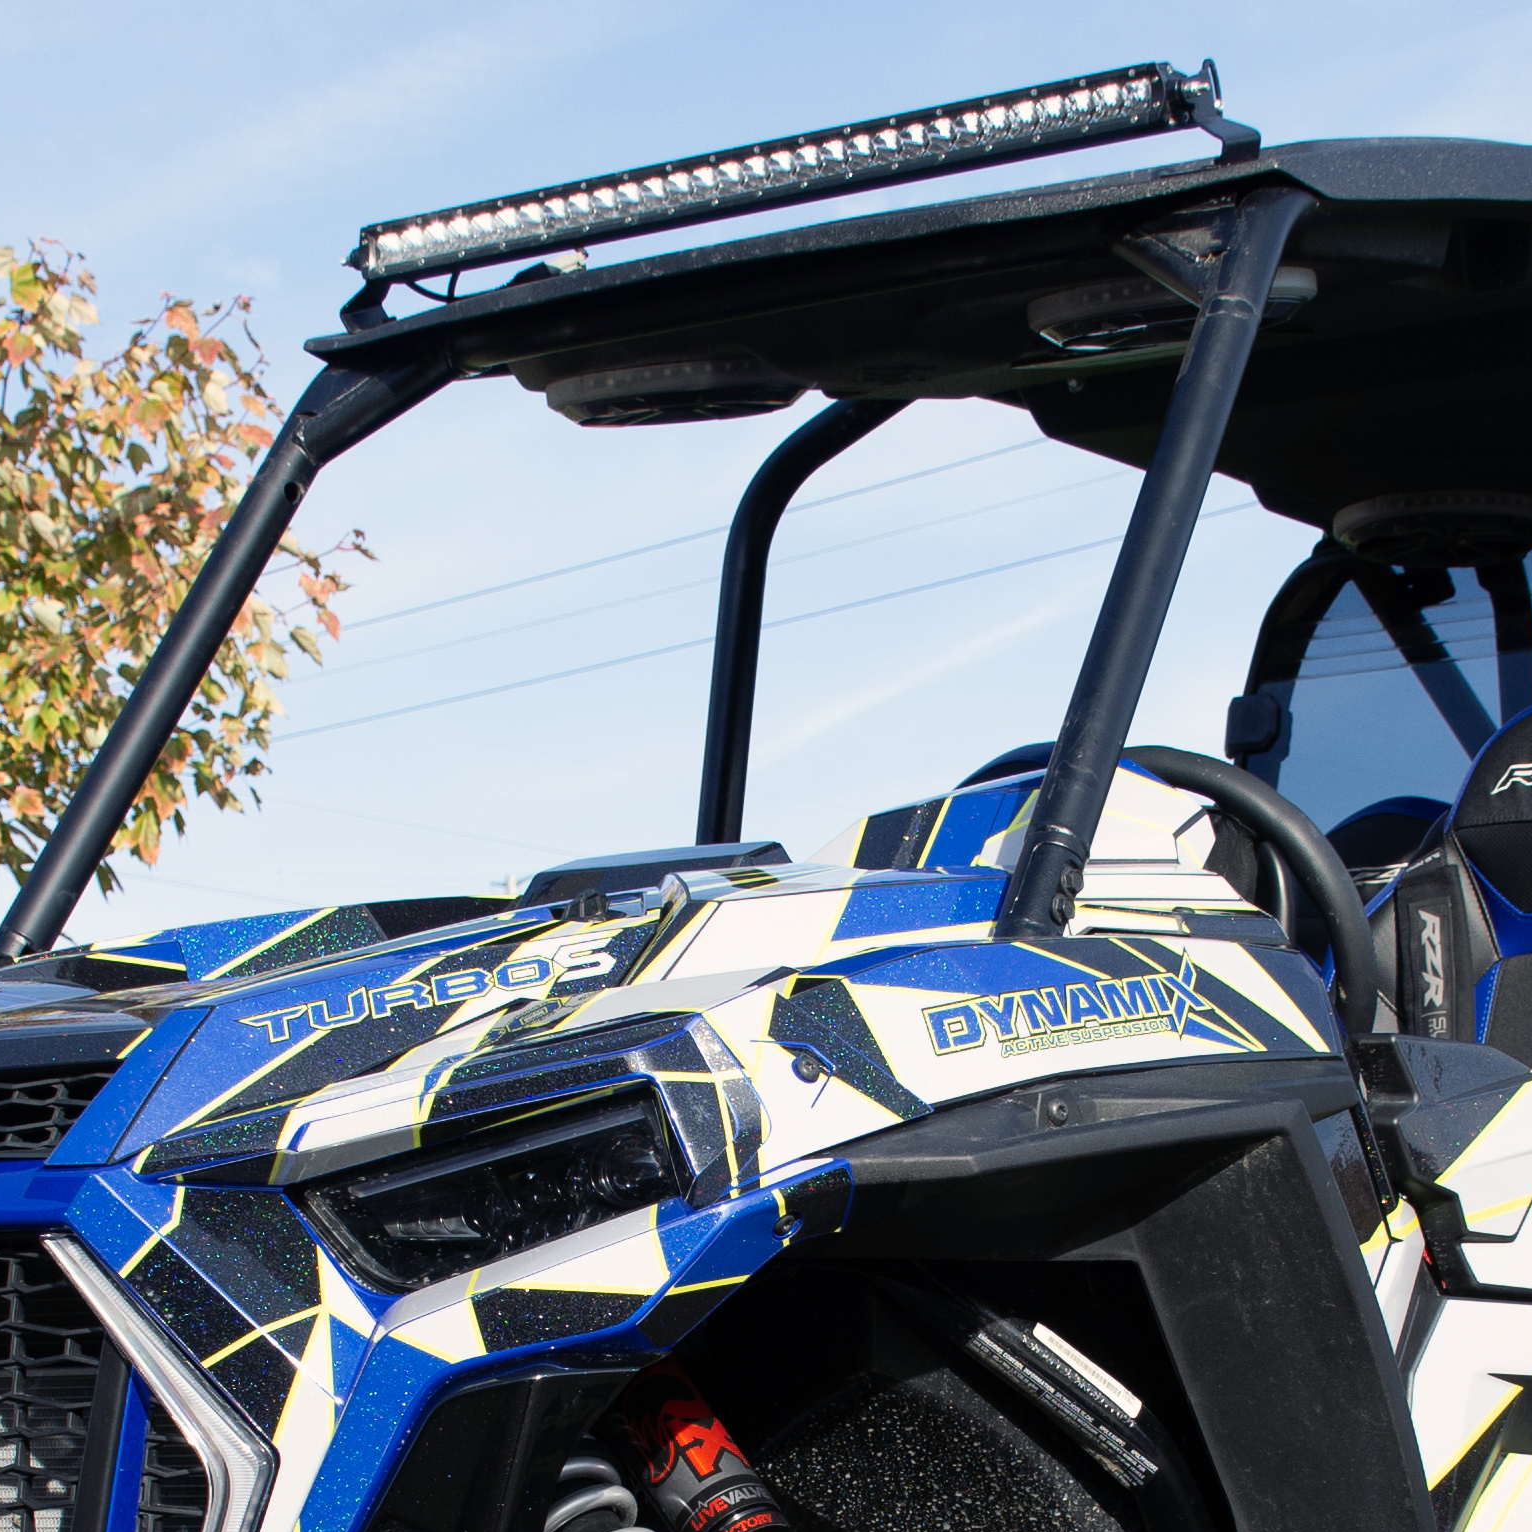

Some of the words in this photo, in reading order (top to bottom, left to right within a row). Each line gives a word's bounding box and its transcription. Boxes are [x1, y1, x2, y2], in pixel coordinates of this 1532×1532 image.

[1419, 909, 1445, 1007] RZR
[923, 948, 1211, 1056] DYNAMIX
[1001, 1032, 1067, 1057] ACTIVE
[1069, 1017, 1171, 1046] SUSPENSION
[1002, 1351, 1025, 1370] CONTROL
[1022, 1366, 1055, 1393] INFORMATION
